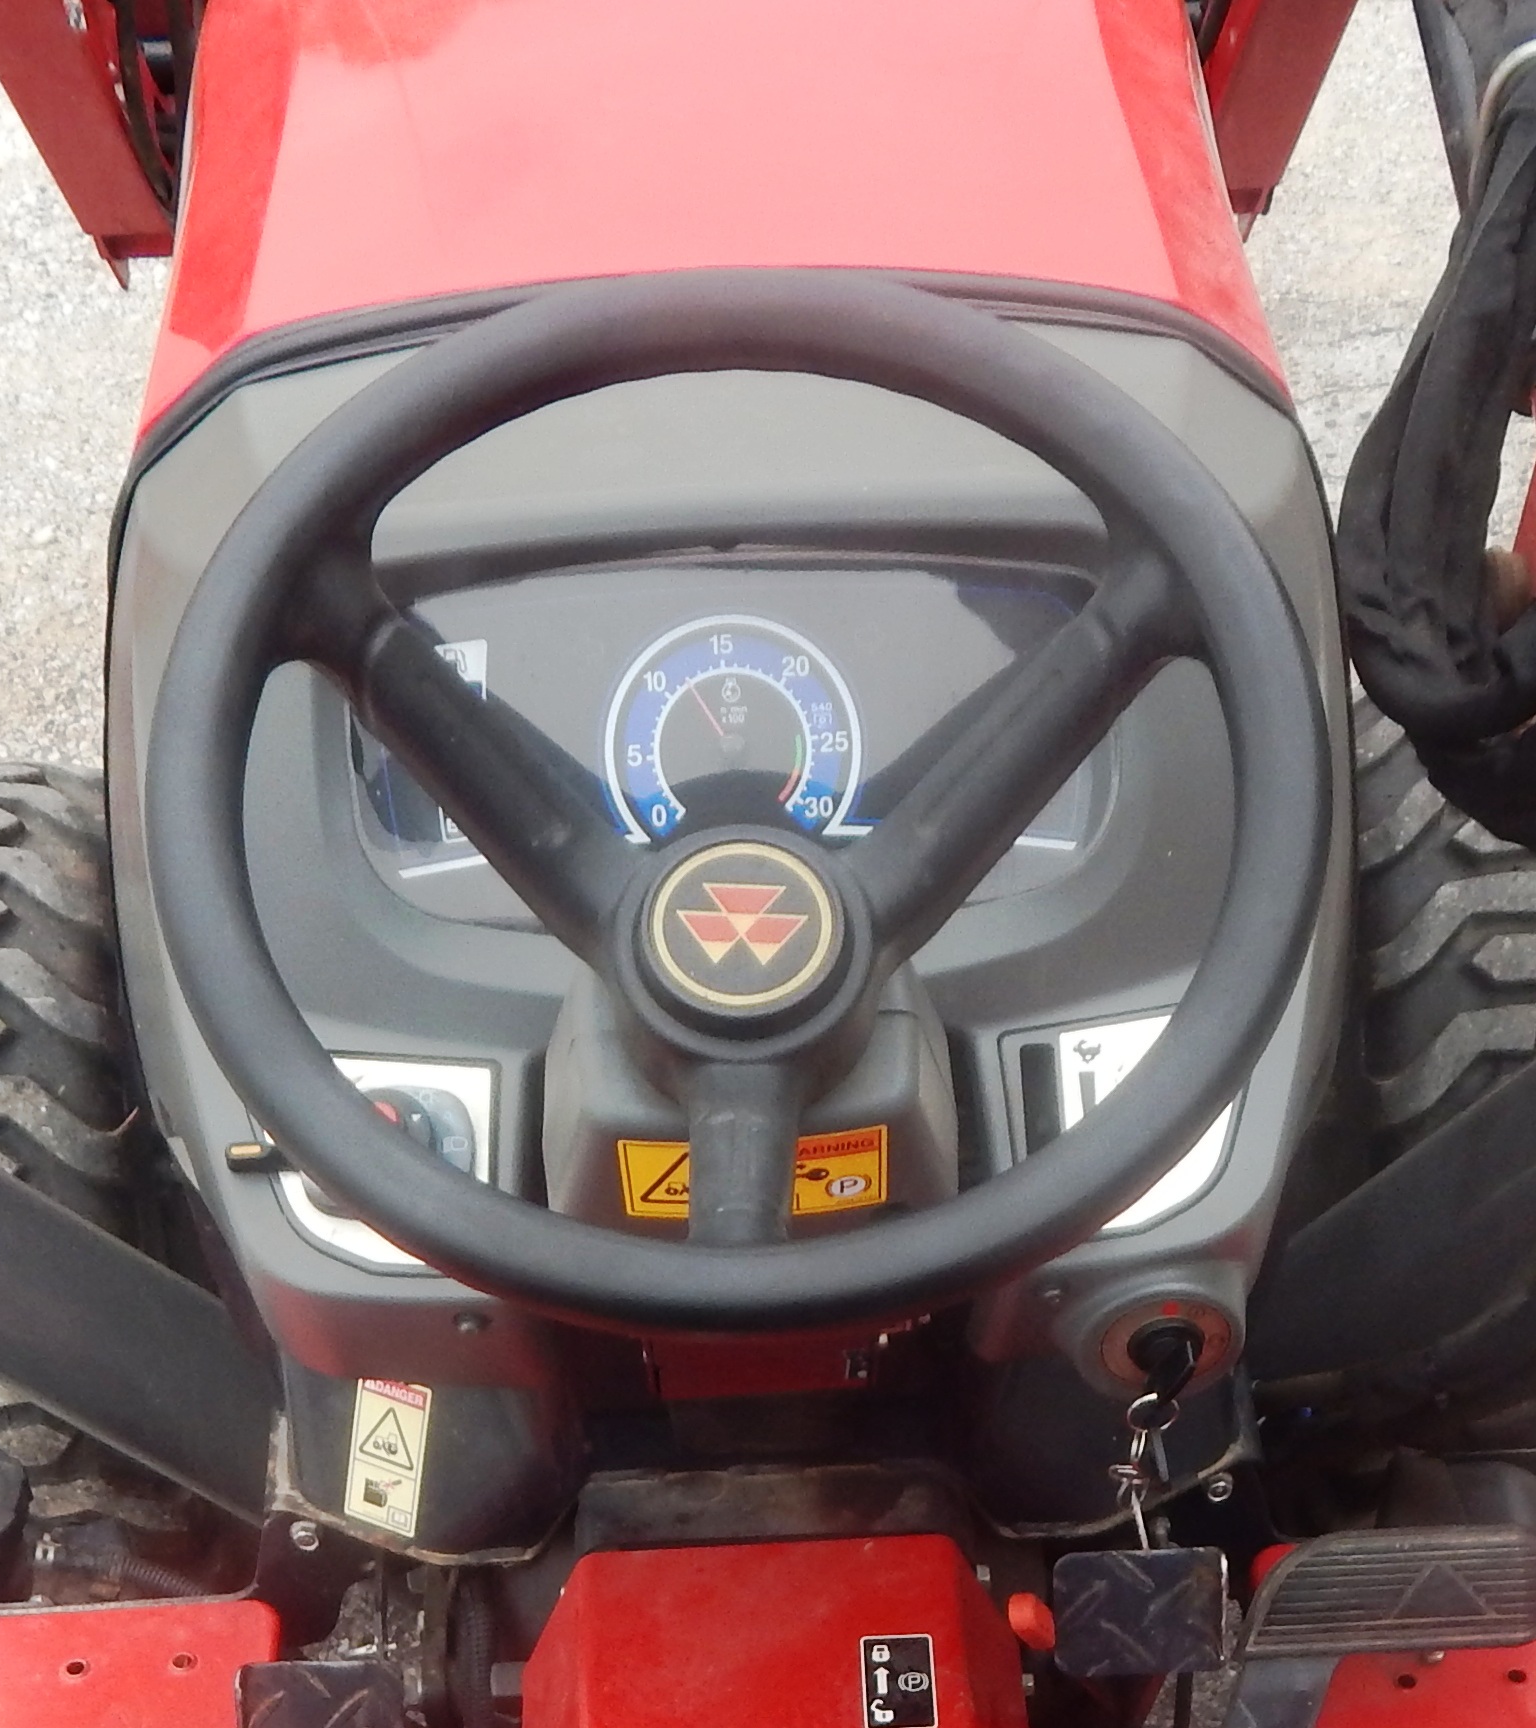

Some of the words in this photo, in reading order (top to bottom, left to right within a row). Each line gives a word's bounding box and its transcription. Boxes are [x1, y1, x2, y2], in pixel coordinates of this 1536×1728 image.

[709, 634, 733, 655] 15
[782, 656, 809, 676] 20
[643, 671, 666, 692] 10
[820, 731, 848, 752] 25
[627, 745, 642, 766] 5
[652, 804, 667, 827] 0
[805, 796, 833, 817] 30
[798, 1138, 875, 1156] ARNING
[374, 1380, 424, 1407] DANGER
